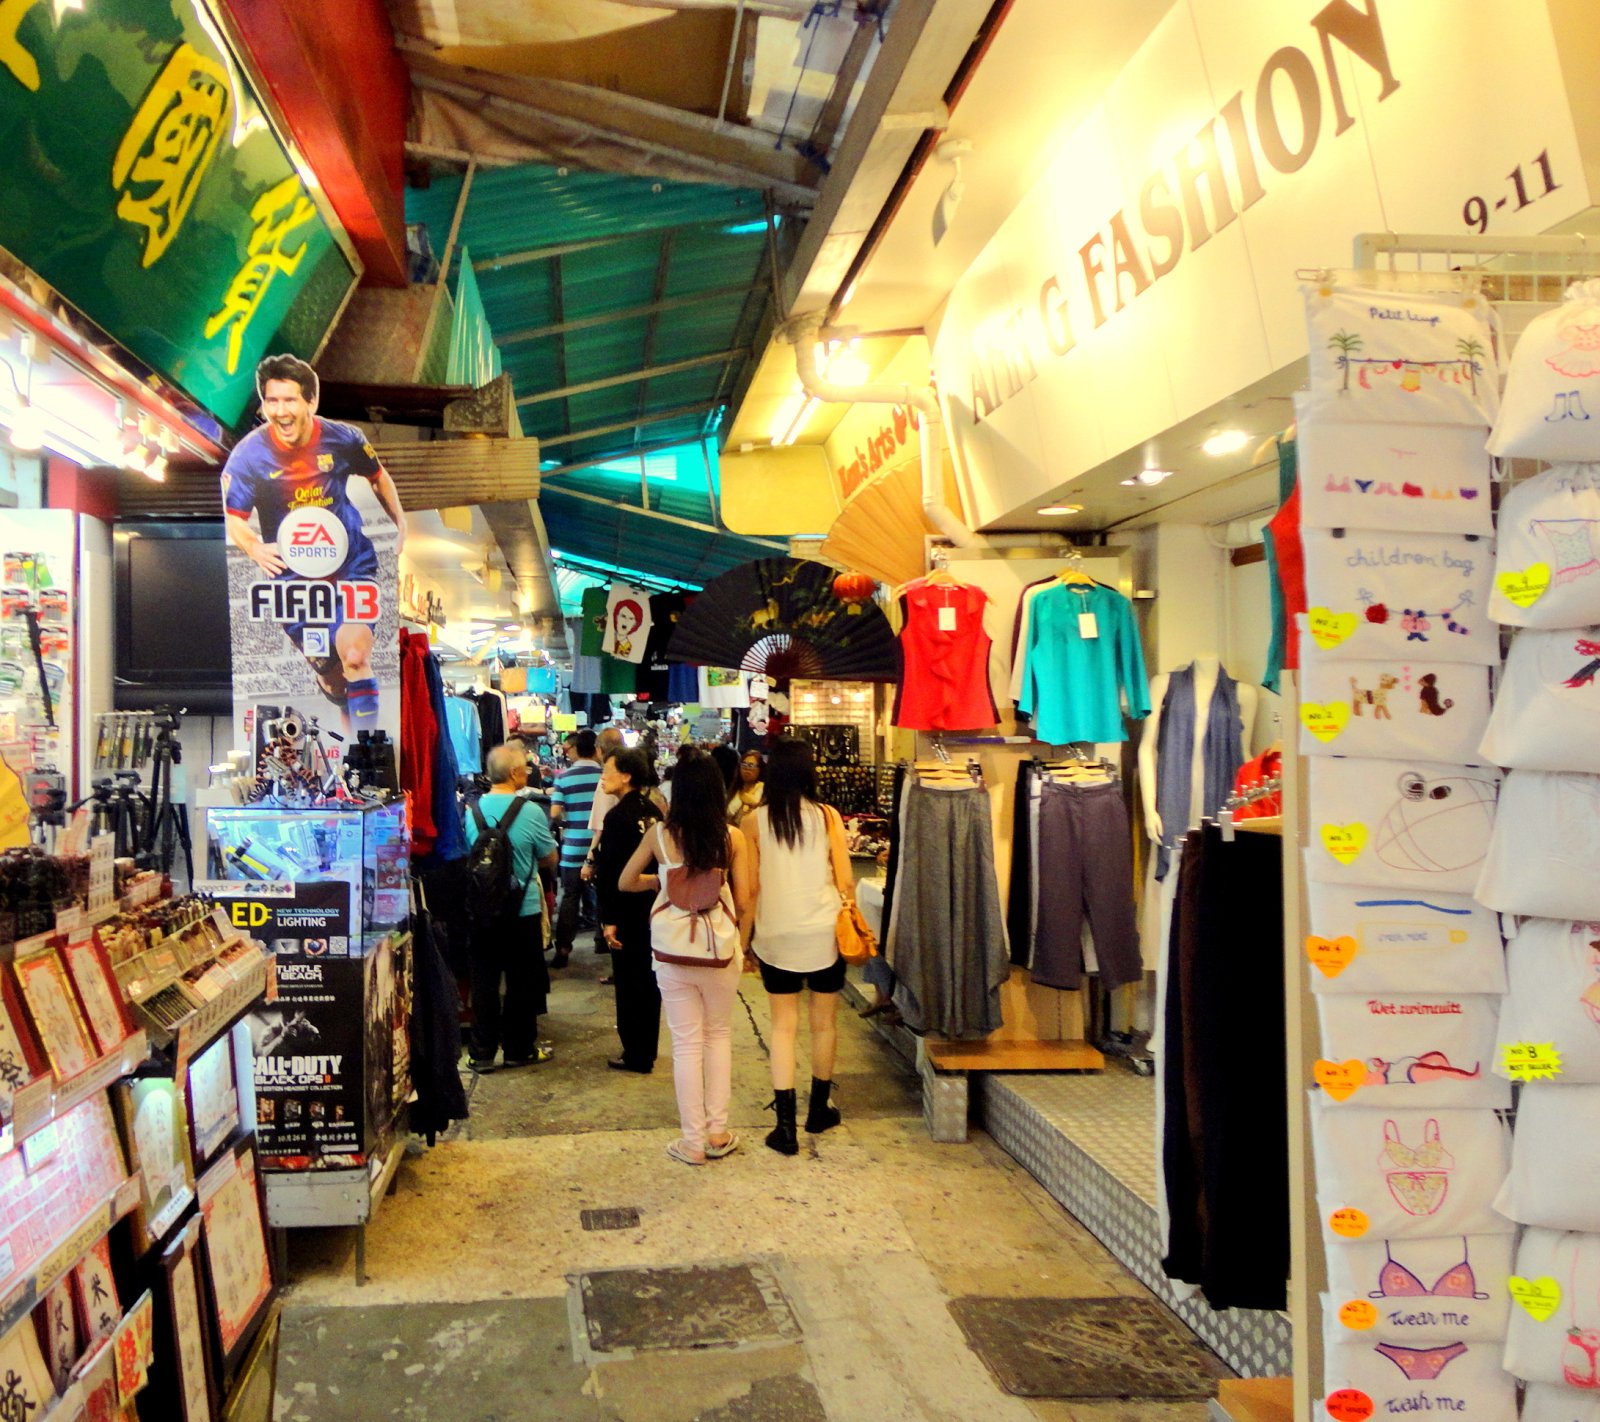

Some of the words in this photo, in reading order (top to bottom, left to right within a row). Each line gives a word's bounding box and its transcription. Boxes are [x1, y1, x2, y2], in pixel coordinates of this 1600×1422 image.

[1078, 0, 1400, 329] FASHION
[1463, 147, 1564, 234] 9-11
[290, 523, 336, 545] EA
[289, 547, 337, 558] SPORTS
[1346, 547, 1439, 568] children
[1443, 550, 1474, 577] bag
[251, 584, 332, 619] FIFA
[340, 584, 380, 620] 13
[215, 902, 272, 927] ED
[277, 917, 327, 927] LIGHTING
[276, 964, 322, 973] TURTLE
[280, 972, 323, 982] BEACH
[1367, 1000, 1396, 1014] Wet
[1527, 1045, 1538, 1059] 8
[292, 1055, 342, 1075] DUTY
[255, 1076, 296, 1084] BLACK
[298, 1075, 323, 1084] OPS
[1388, 1310, 1437, 1326] wear
[1441, 1312, 1470, 1326] me
[1384, 1391, 1431, 1413] wash
[1438, 1397, 1467, 1412] me
